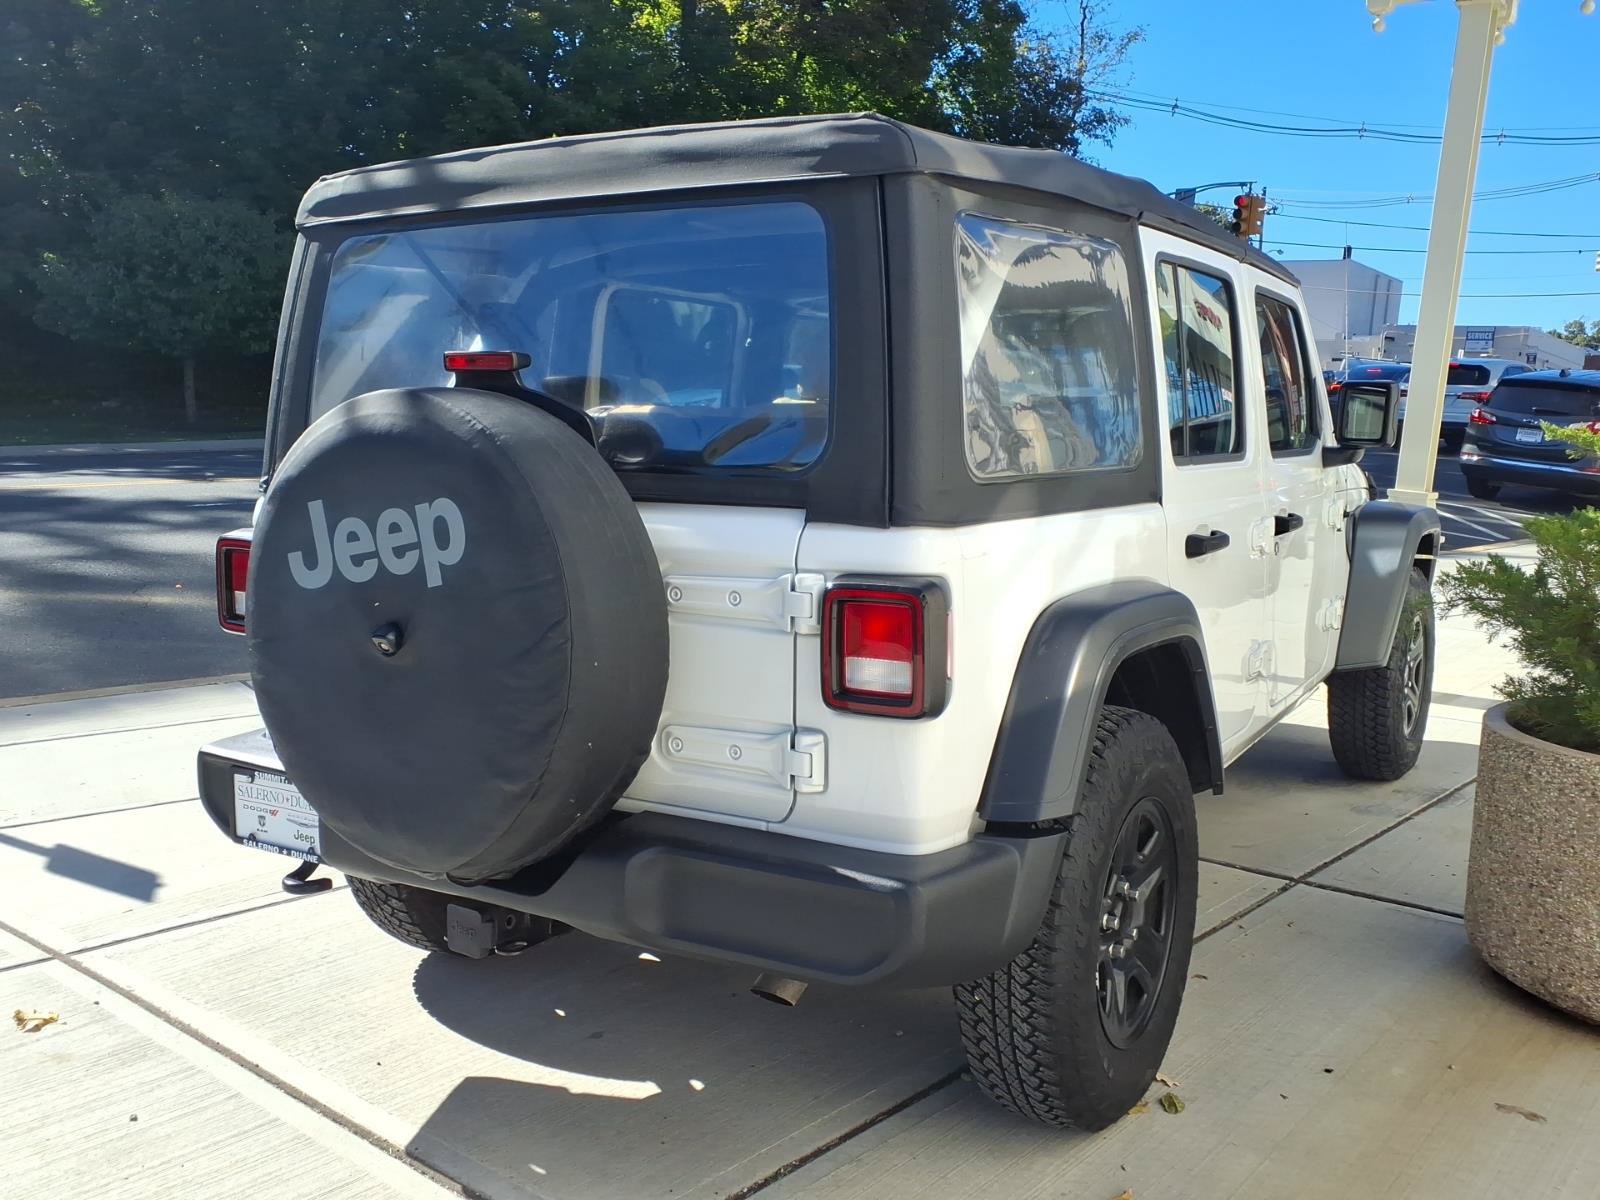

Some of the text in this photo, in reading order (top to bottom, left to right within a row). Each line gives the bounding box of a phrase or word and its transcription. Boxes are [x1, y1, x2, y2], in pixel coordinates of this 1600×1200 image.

[1467, 332, 1493, 340] SERVICE
[287, 497, 466, 589] Jeep
[237, 785, 313, 812] SALERNO DUA
[242, 803, 273, 816] DODGE
[294, 829, 316, 846] Jeep
[242, 838, 319, 864] SALERNO DUANE
